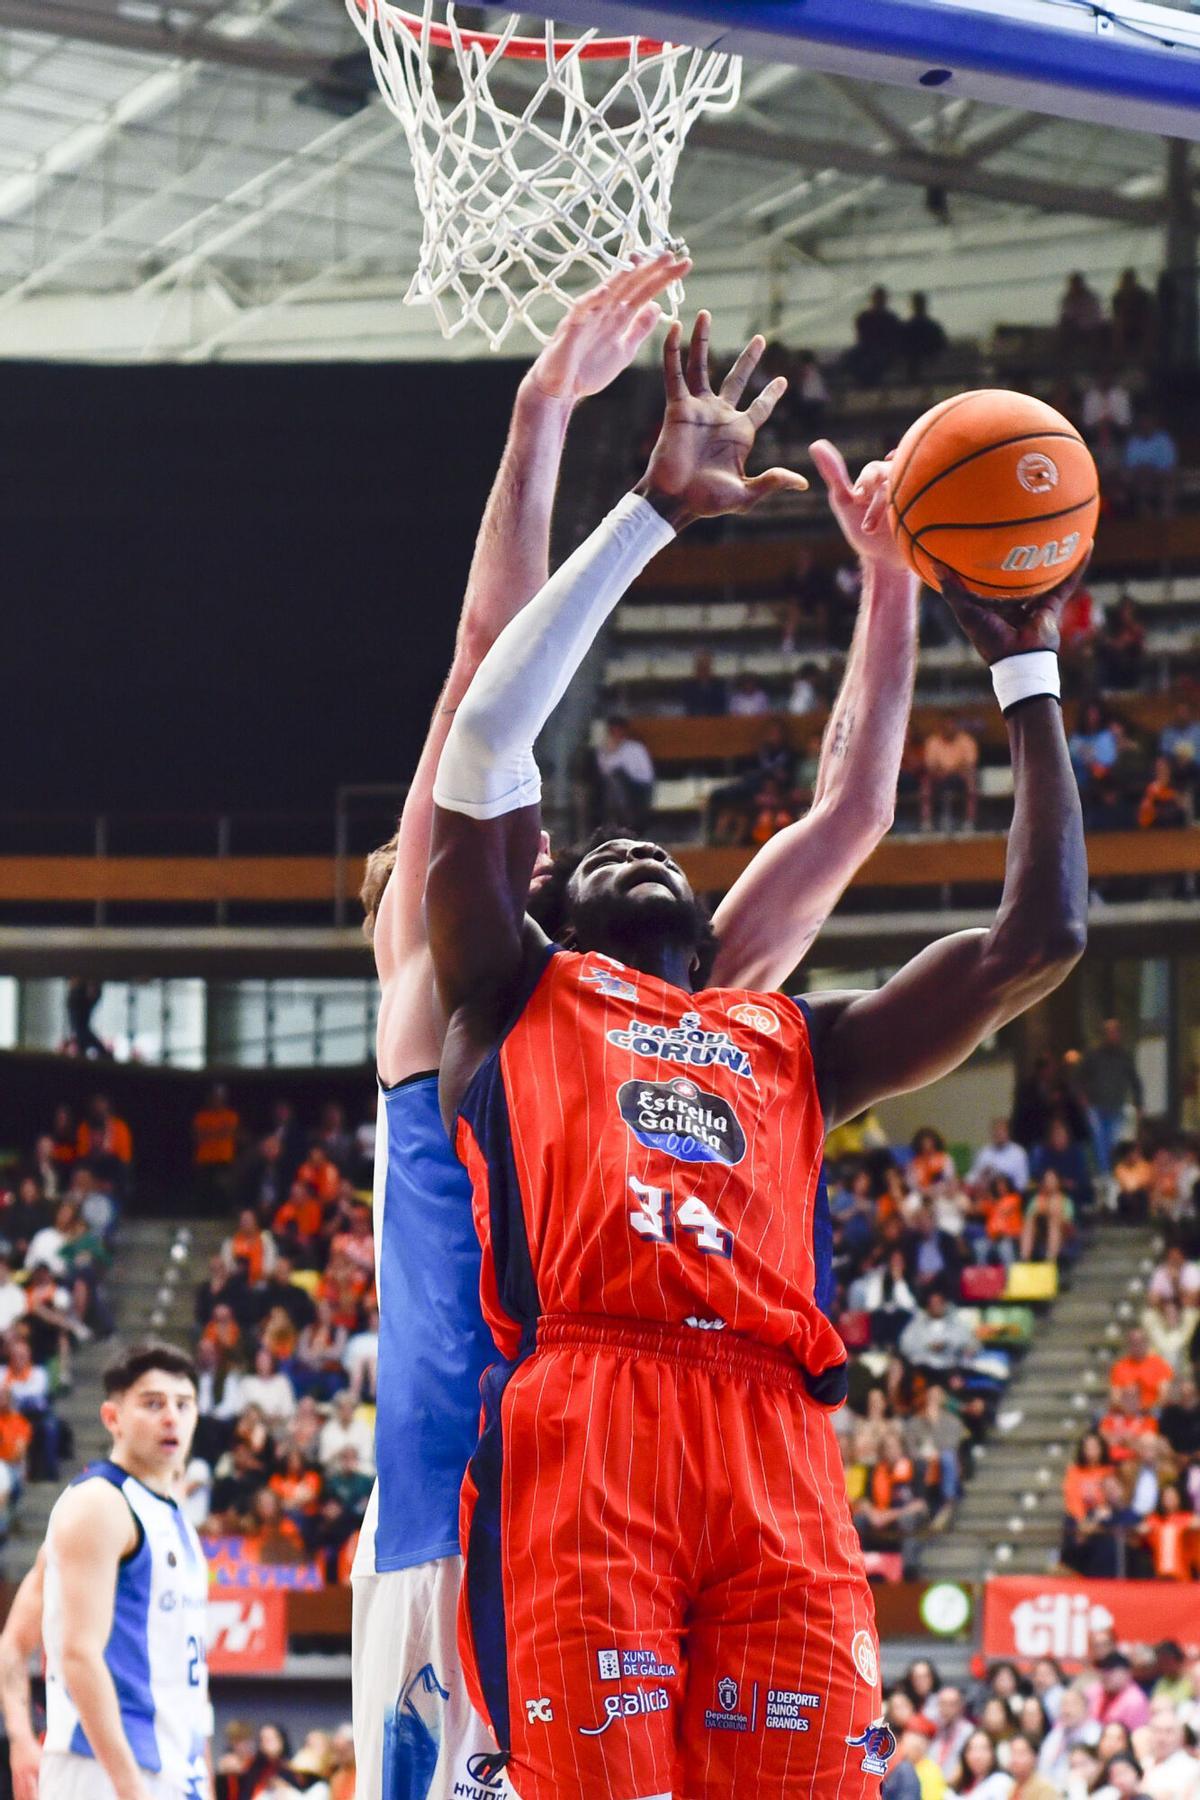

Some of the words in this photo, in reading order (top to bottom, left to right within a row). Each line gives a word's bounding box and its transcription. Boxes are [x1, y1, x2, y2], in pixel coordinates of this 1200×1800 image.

[637, 1091, 728, 1132] Estrella
[638, 1110, 720, 1150] Galicia
[629, 1176, 733, 1258] 34
[623, 1652, 656, 1662] XUNTA
[624, 1665, 639, 1675] DE
[640, 1665, 676, 1676] GALICIA
[768, 1691, 774, 1702] O
[777, 1691, 820, 1707] DEPORTE
[580, 1686, 669, 1735] galicia
[705, 1710, 747, 1723] Deputación
[767, 1703, 799, 1717] FAINOS
[766, 1717, 809, 1731] GRANDES
